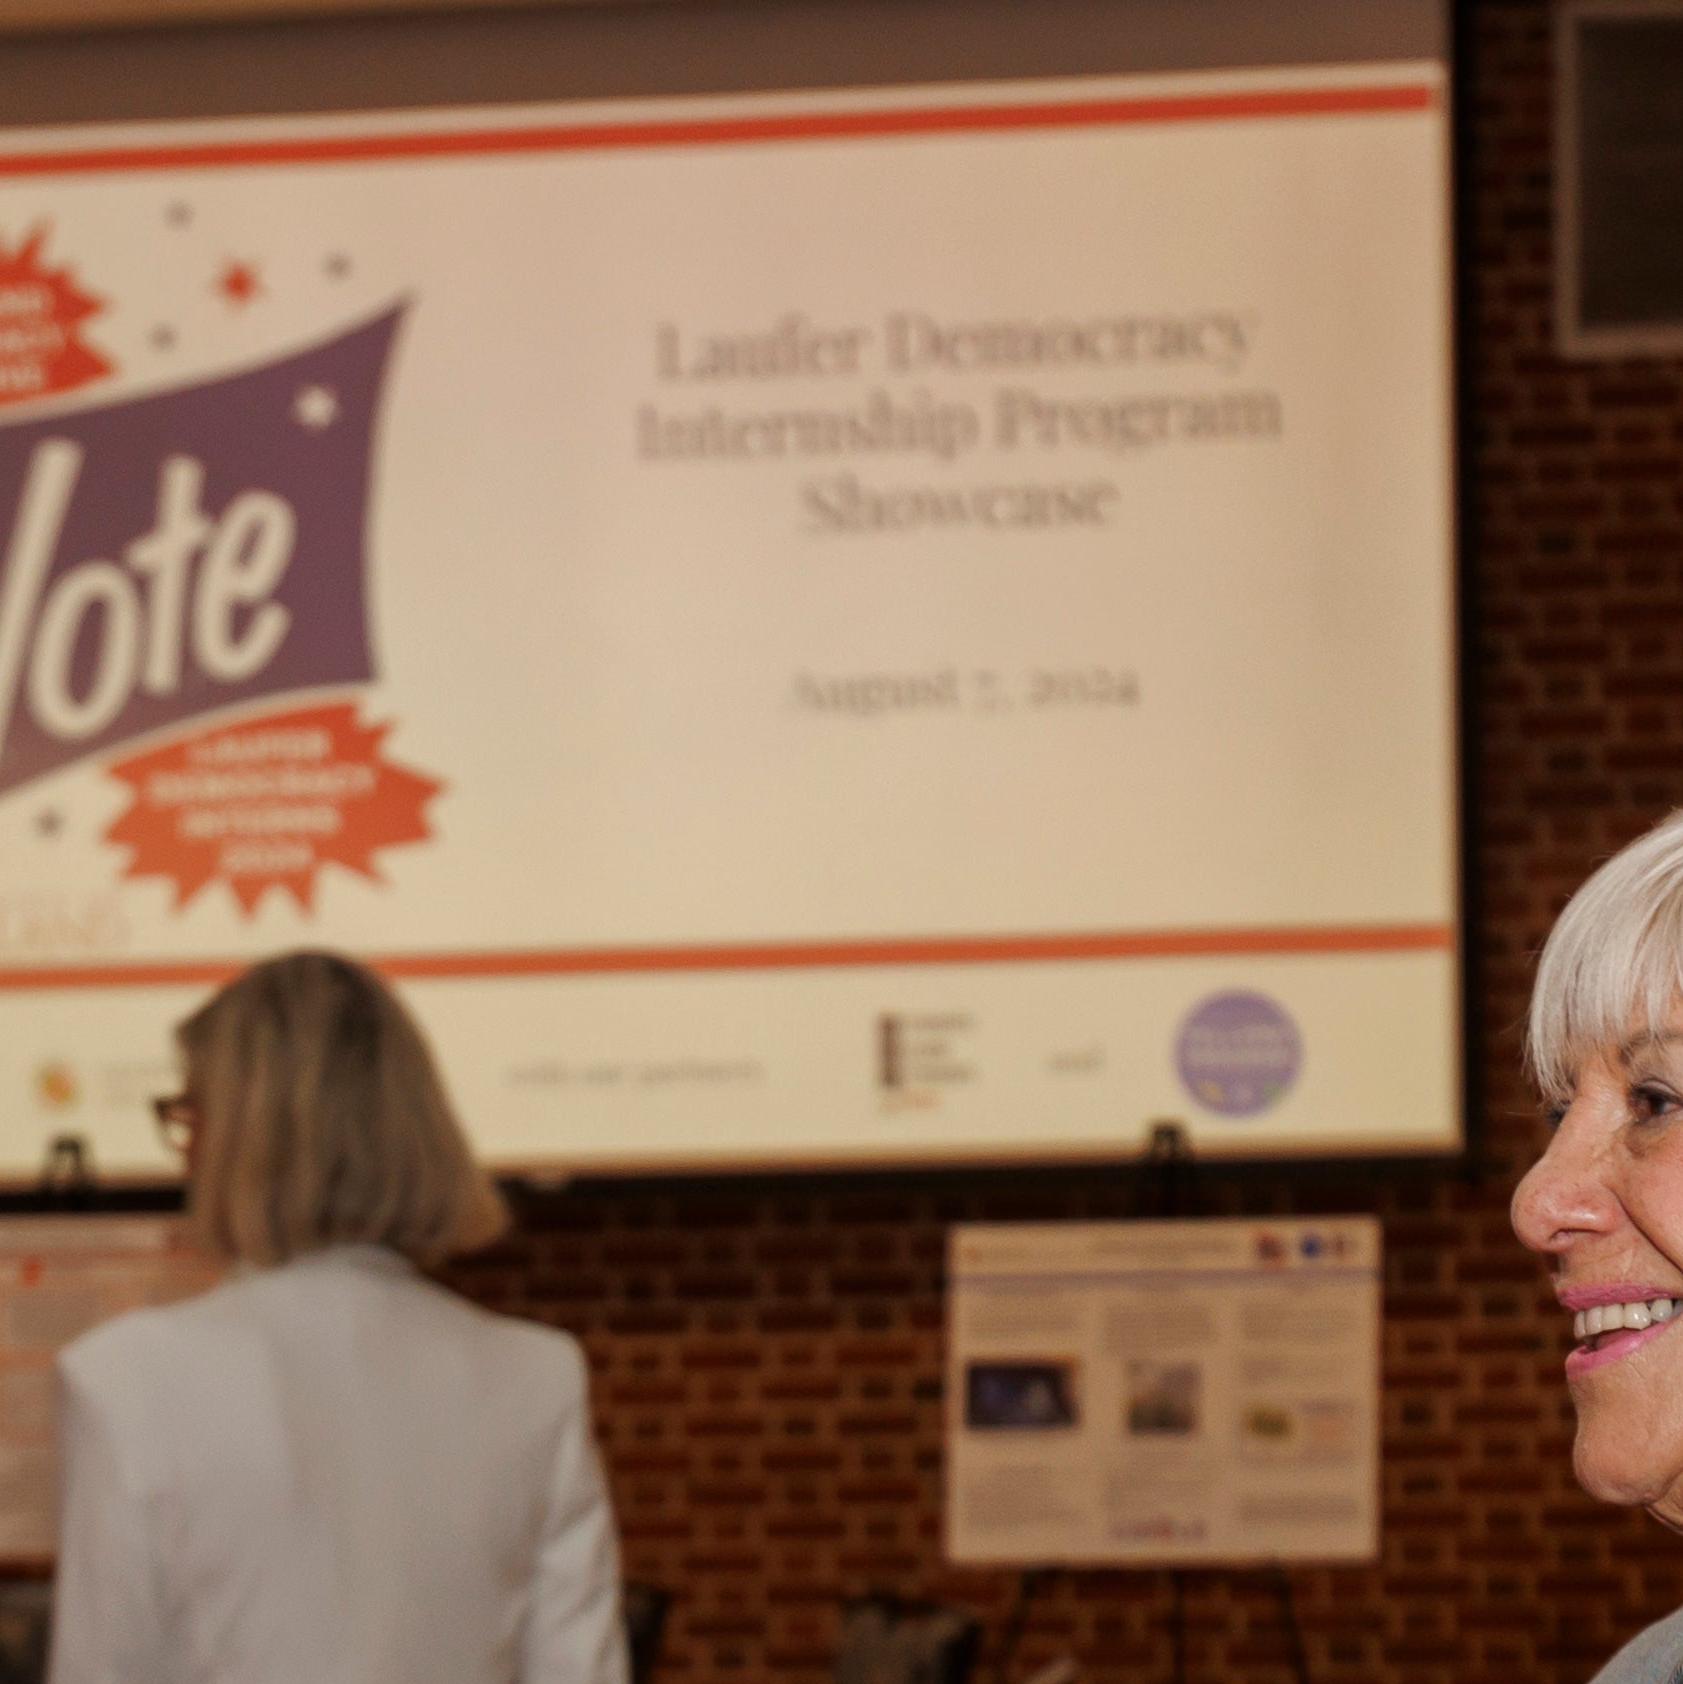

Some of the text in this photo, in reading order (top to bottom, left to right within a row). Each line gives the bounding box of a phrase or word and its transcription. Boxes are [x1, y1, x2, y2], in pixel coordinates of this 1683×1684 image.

[655, 307, 1252, 383] Laufer Democracy
[634, 386, 1285, 464] Internship Program
[798, 472, 1118, 536] Showcase
[792, 668, 958, 717] August
